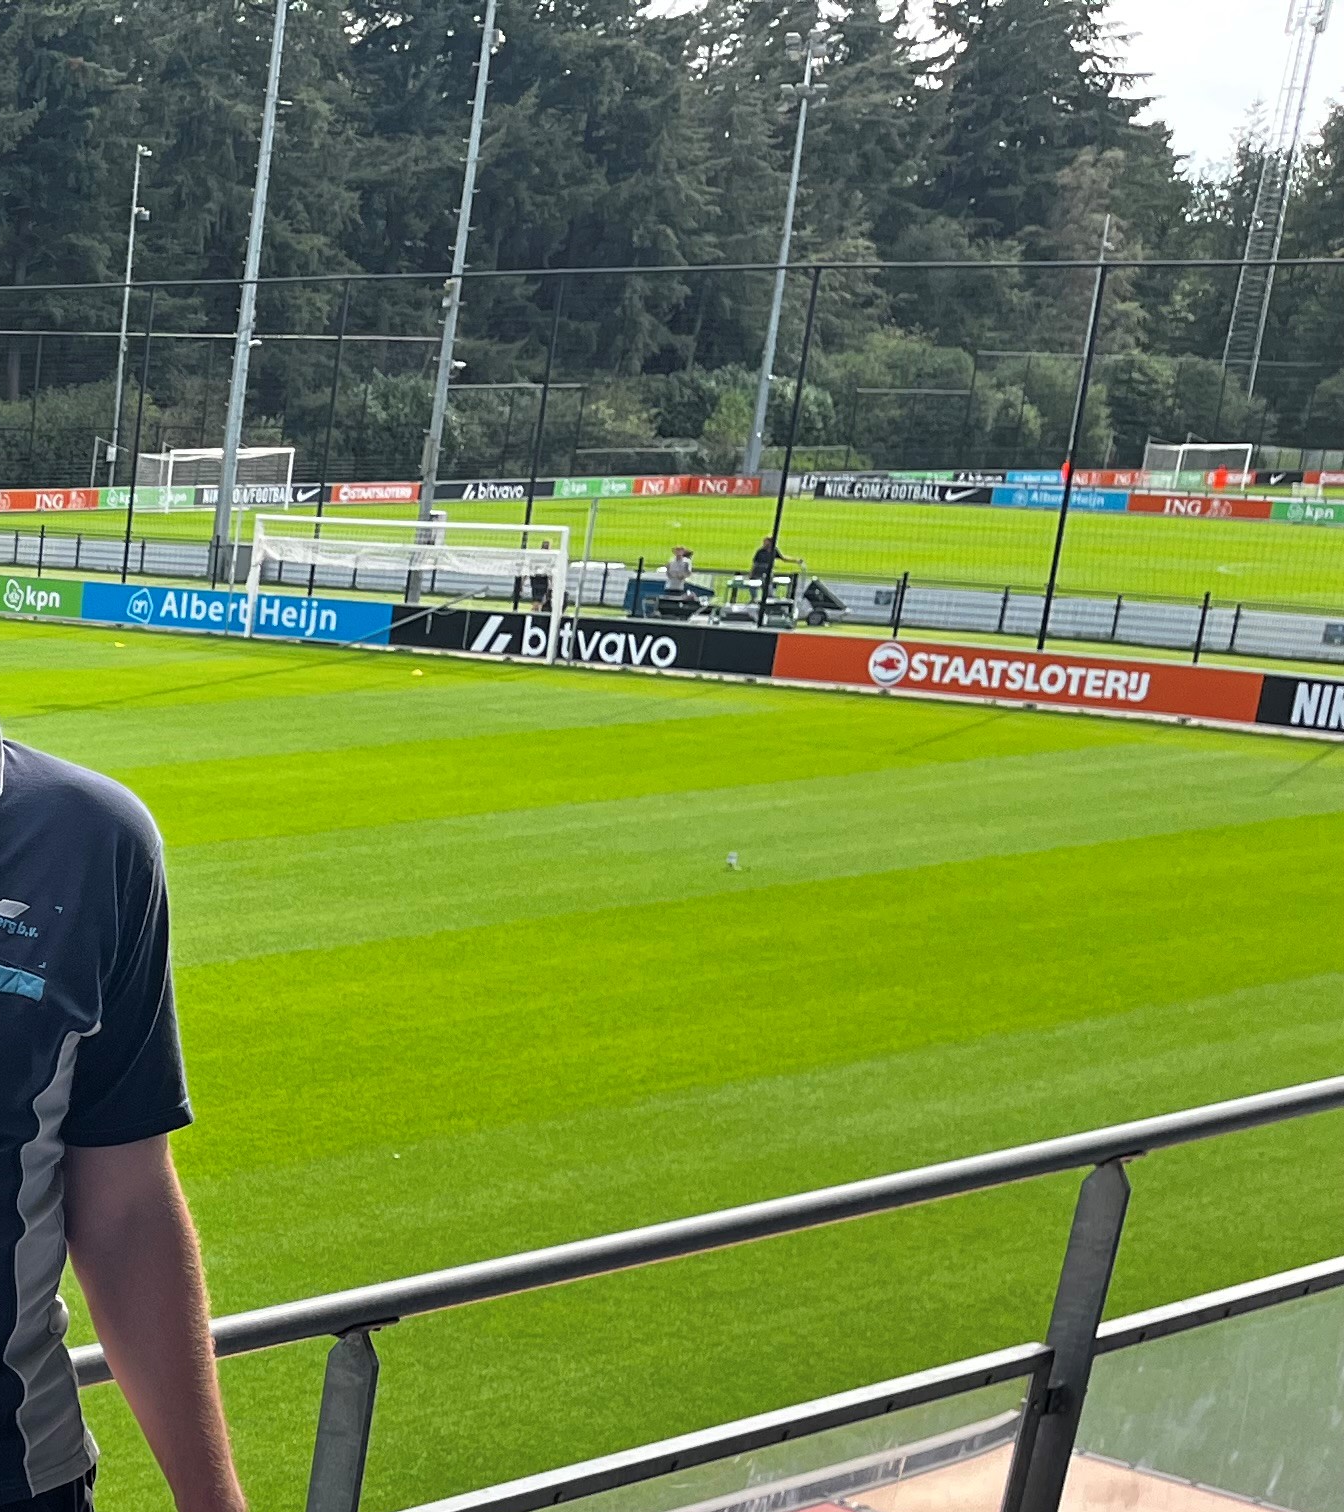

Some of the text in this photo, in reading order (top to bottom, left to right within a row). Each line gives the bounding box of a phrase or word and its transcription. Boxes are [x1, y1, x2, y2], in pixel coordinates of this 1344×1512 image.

[698, 479, 728, 494] ING
[35, 492, 64, 510] ING
[1164, 498, 1202, 515] ING
[1305, 504, 1335, 521] kpn
[26, 585, 60, 612] kpn
[159, 590, 250, 625] Albert
[259, 596, 337, 637] Heijn
[522, 615, 678, 668] btvavo
[908, 652, 1150, 702] STAATSLOTERIJ
